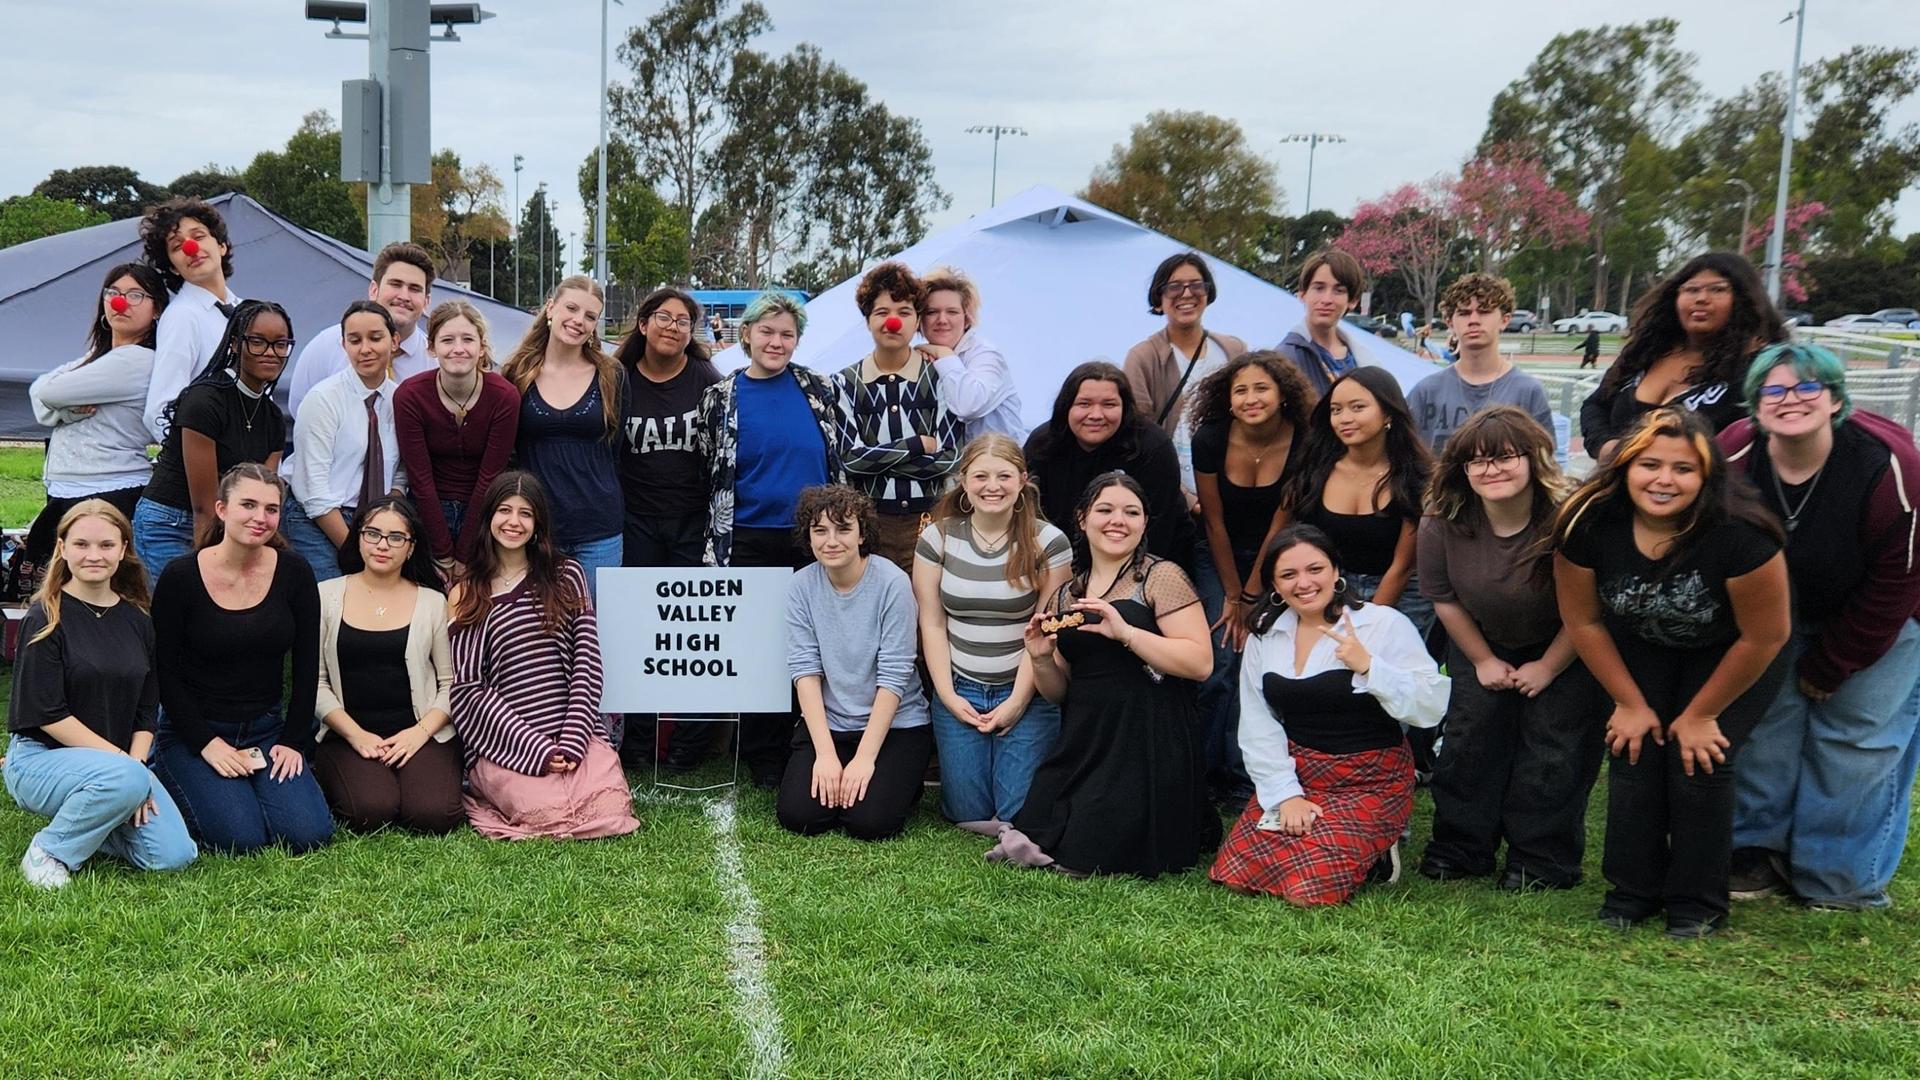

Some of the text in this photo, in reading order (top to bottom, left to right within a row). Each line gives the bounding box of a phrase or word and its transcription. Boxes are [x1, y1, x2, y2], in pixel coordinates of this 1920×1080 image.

[656, 579, 743, 598] GOLDEN
[657, 604, 737, 622] VALLEY
[655, 633, 720, 652] HIGH
[643, 657, 738, 677] SCHOOL
